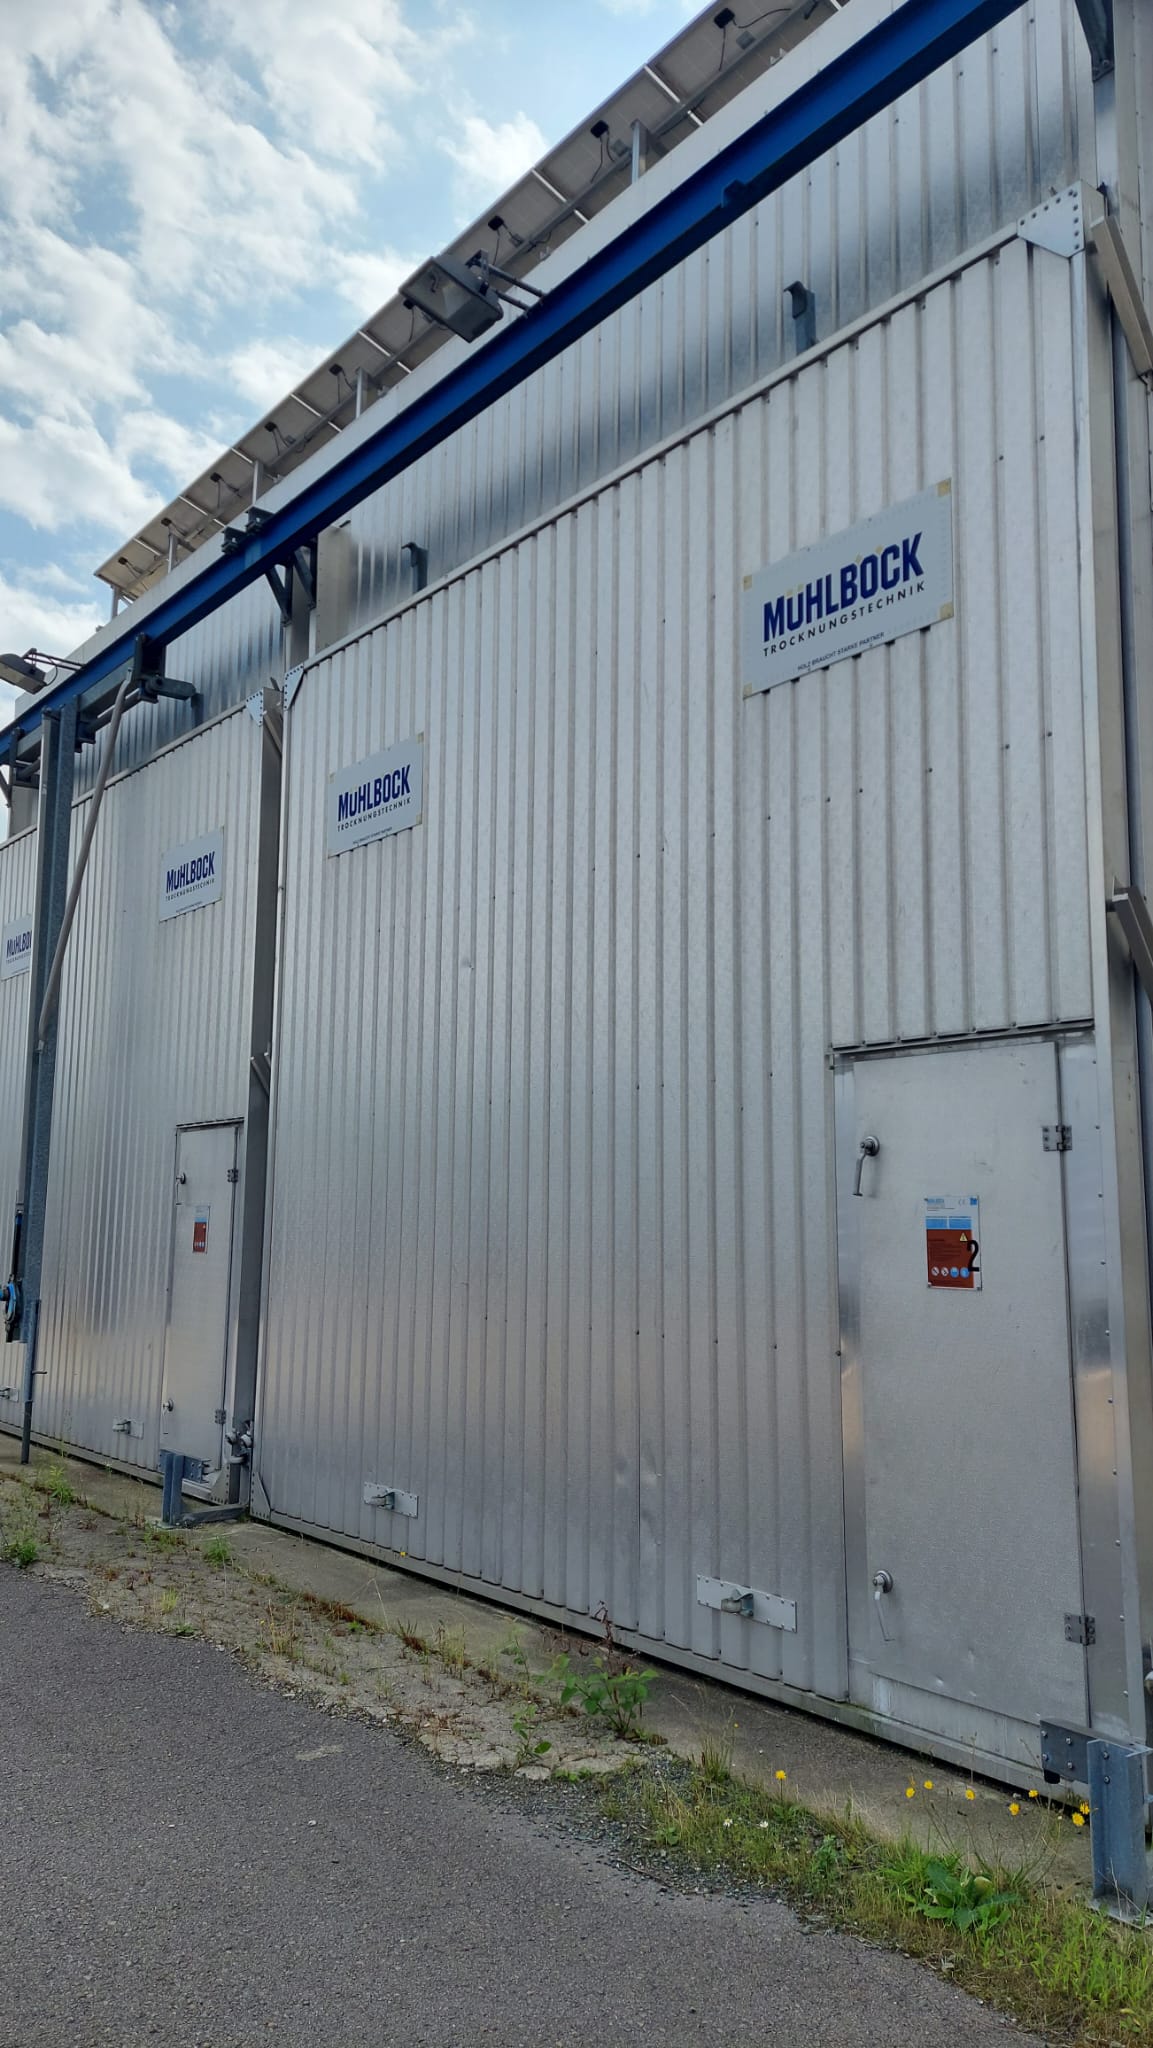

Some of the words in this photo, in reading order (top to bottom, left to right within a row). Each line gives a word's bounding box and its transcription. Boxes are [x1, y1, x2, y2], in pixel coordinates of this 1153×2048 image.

[763, 580, 926, 657] TROCKNUNGSTECHNIK
[859, 632, 885, 646] PARTNER
[337, 796, 411, 832] TROCKNUNGSTECHNIK
[967, 1240, 979, 1272] 2
